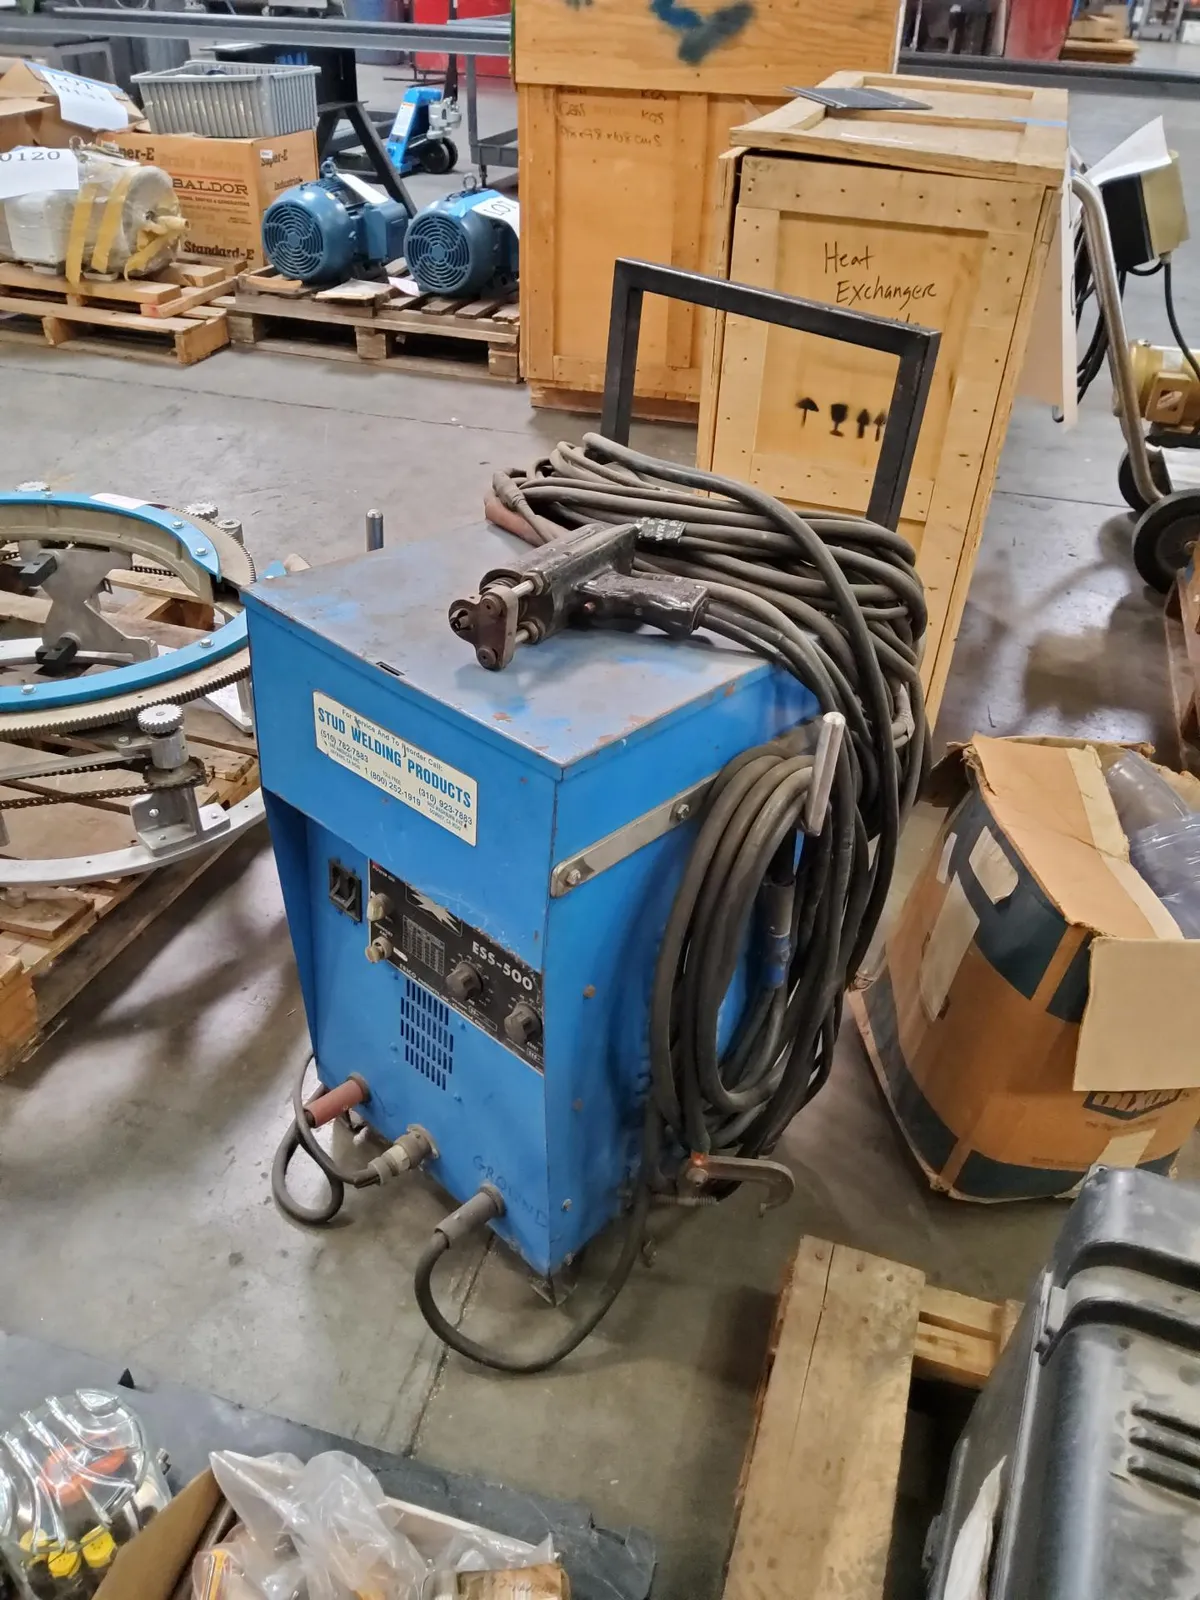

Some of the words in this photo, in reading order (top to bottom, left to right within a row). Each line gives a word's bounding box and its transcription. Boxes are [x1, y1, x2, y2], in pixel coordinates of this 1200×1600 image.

[0, 150, 61, 162] 0120
[119, 147, 155, 161] per-E
[172, 178, 249, 195] BALDOR
[184, 240, 255, 260] Standard-E
[824, 241, 875, 274] Heat
[836, 276, 937, 311] Exchanger
[320, 729, 336, 746] (510)
[342, 709, 352, 719] For
[354, 716, 376, 733] Service
[377, 729, 390, 741] And
[391, 737, 400, 747] To
[428, 758, 443, 772] Call:
[318, 707, 346, 734] STUD
[351, 725, 402, 768] WELDING
[407, 758, 471, 808] PRODUCTS
[364, 767, 368, 775] 1
[370, 770, 388, 787] (800)
[388, 781, 421, 807] 252-1919
[418, 787, 437, 805] (310)
[439, 799, 473, 825] 923-7883
[472, 941, 533, 991] ESS-500
